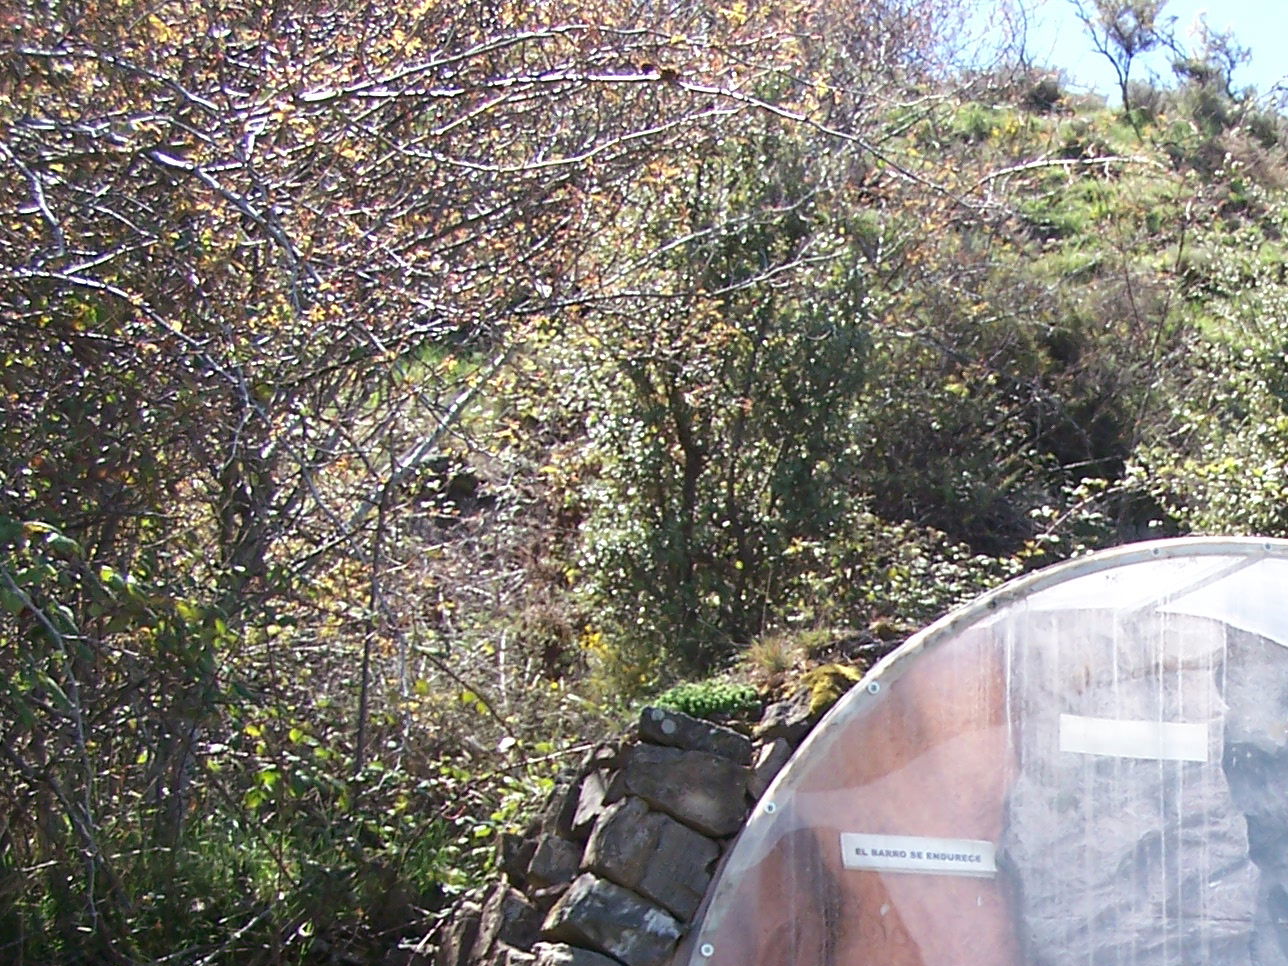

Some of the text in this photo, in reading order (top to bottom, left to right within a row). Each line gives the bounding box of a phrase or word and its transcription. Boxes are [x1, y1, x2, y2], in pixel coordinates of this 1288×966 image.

[855, 847, 982, 863] EL BARRO SE ENDURECE
